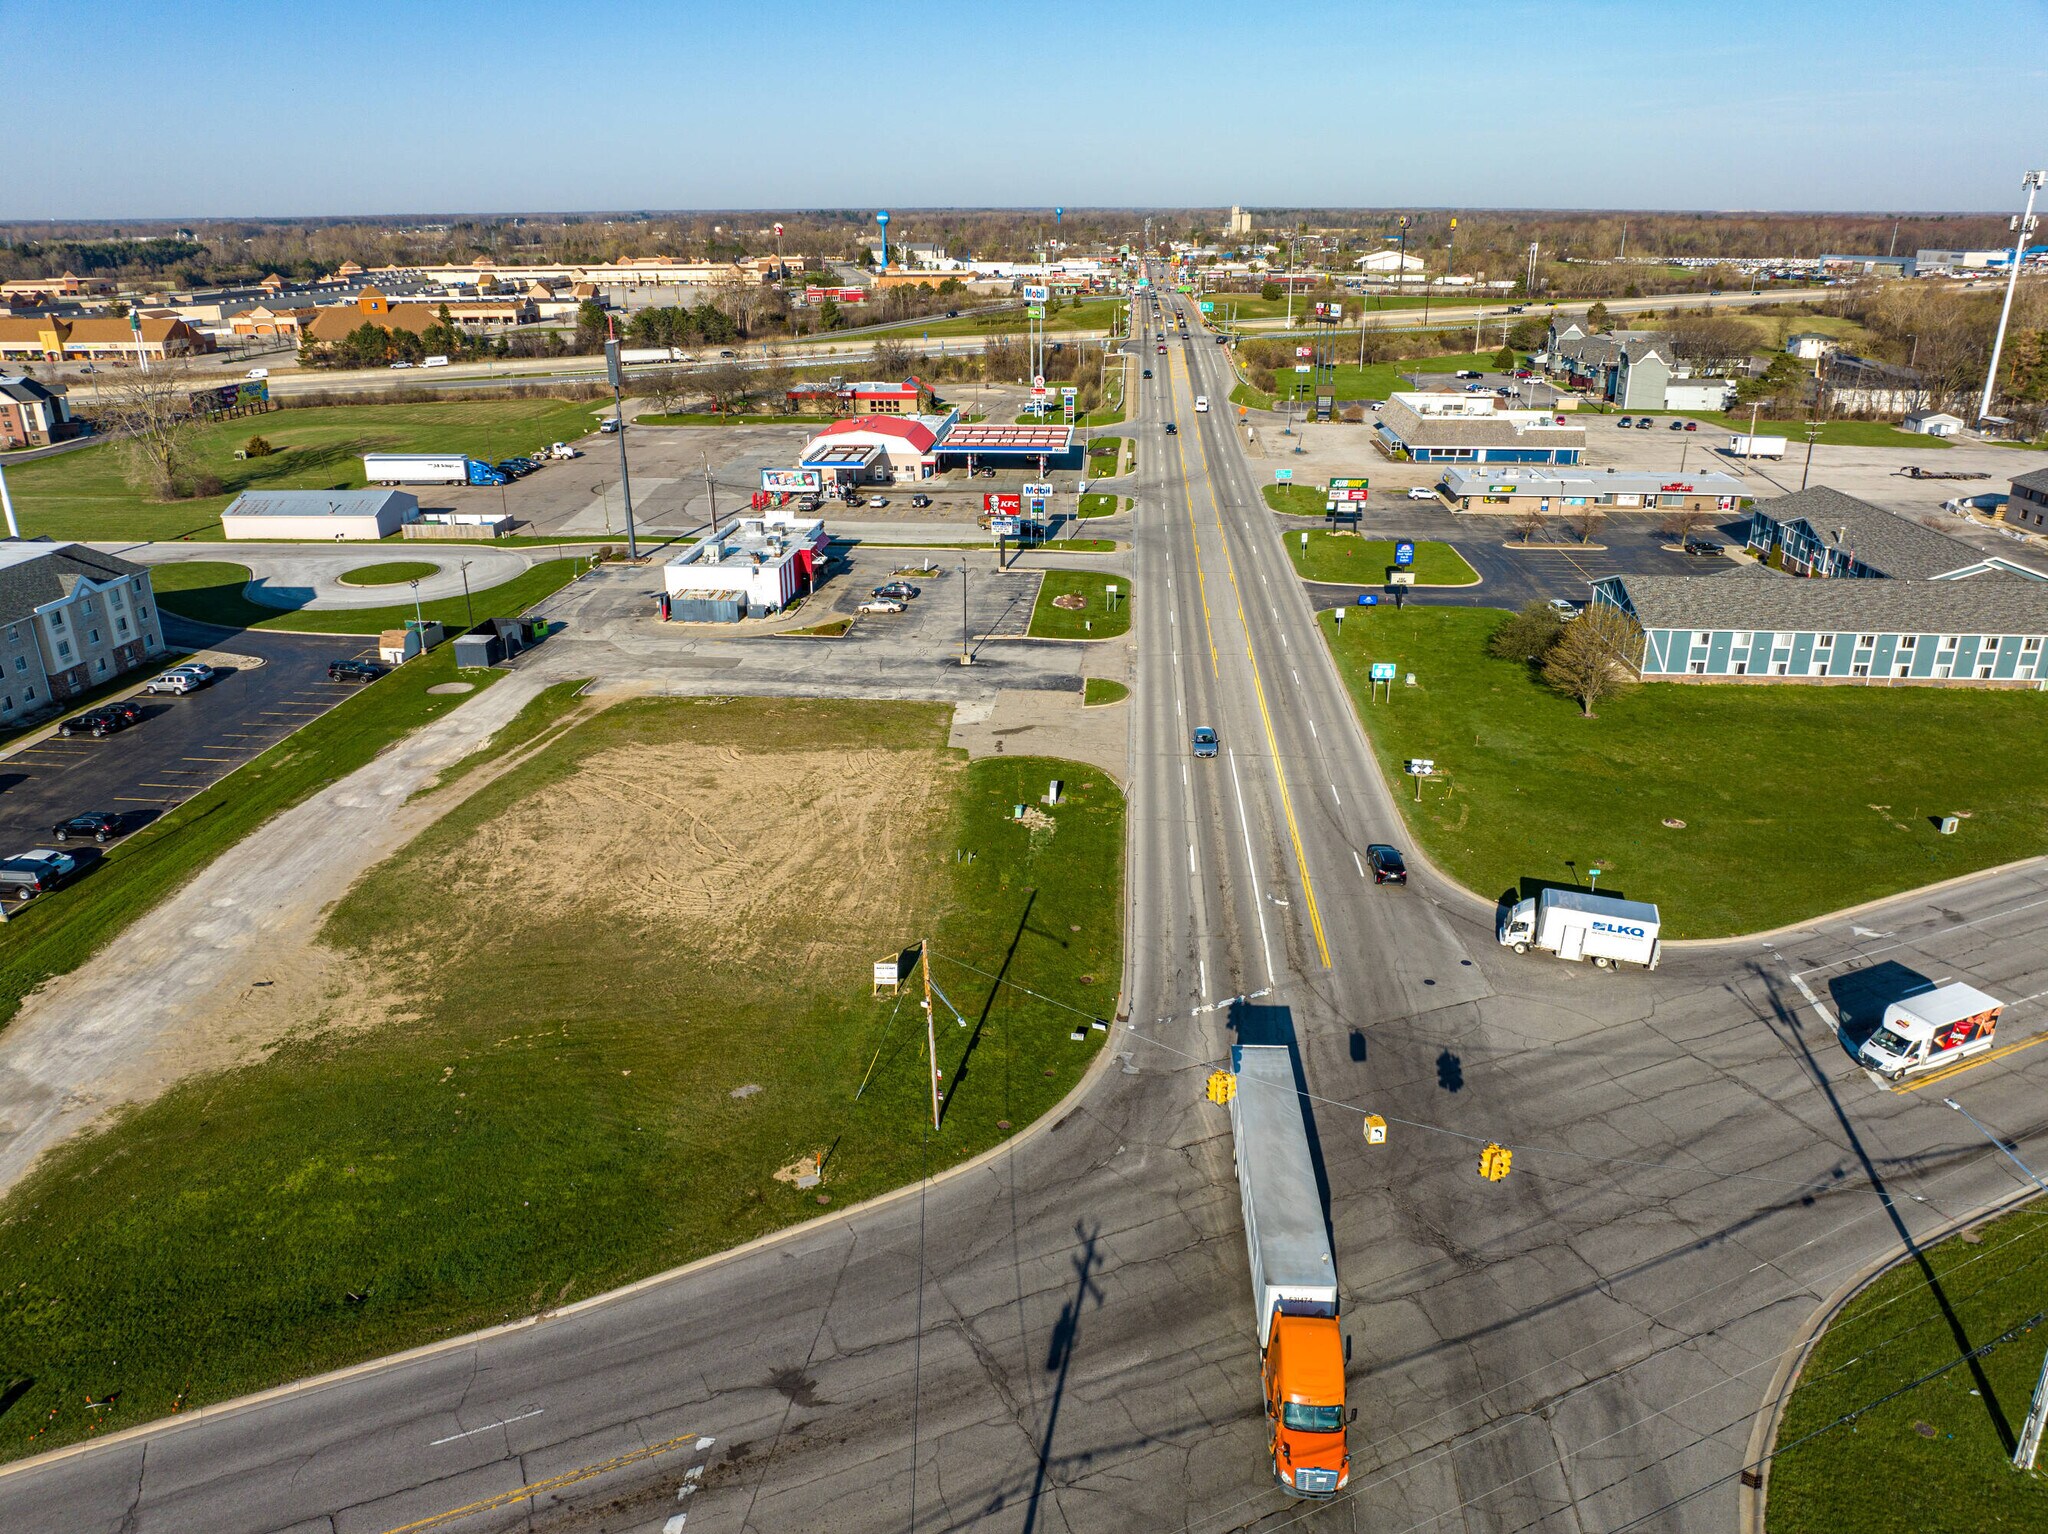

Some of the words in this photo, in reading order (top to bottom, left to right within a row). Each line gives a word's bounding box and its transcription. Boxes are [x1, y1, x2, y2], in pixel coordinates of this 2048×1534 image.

[1025, 288, 1045, 299] Mobil
[1333, 479, 1367, 488] SUBWAY
[1025, 486, 1050, 494] Mobil
[1607, 924, 1645, 937] LKQ
